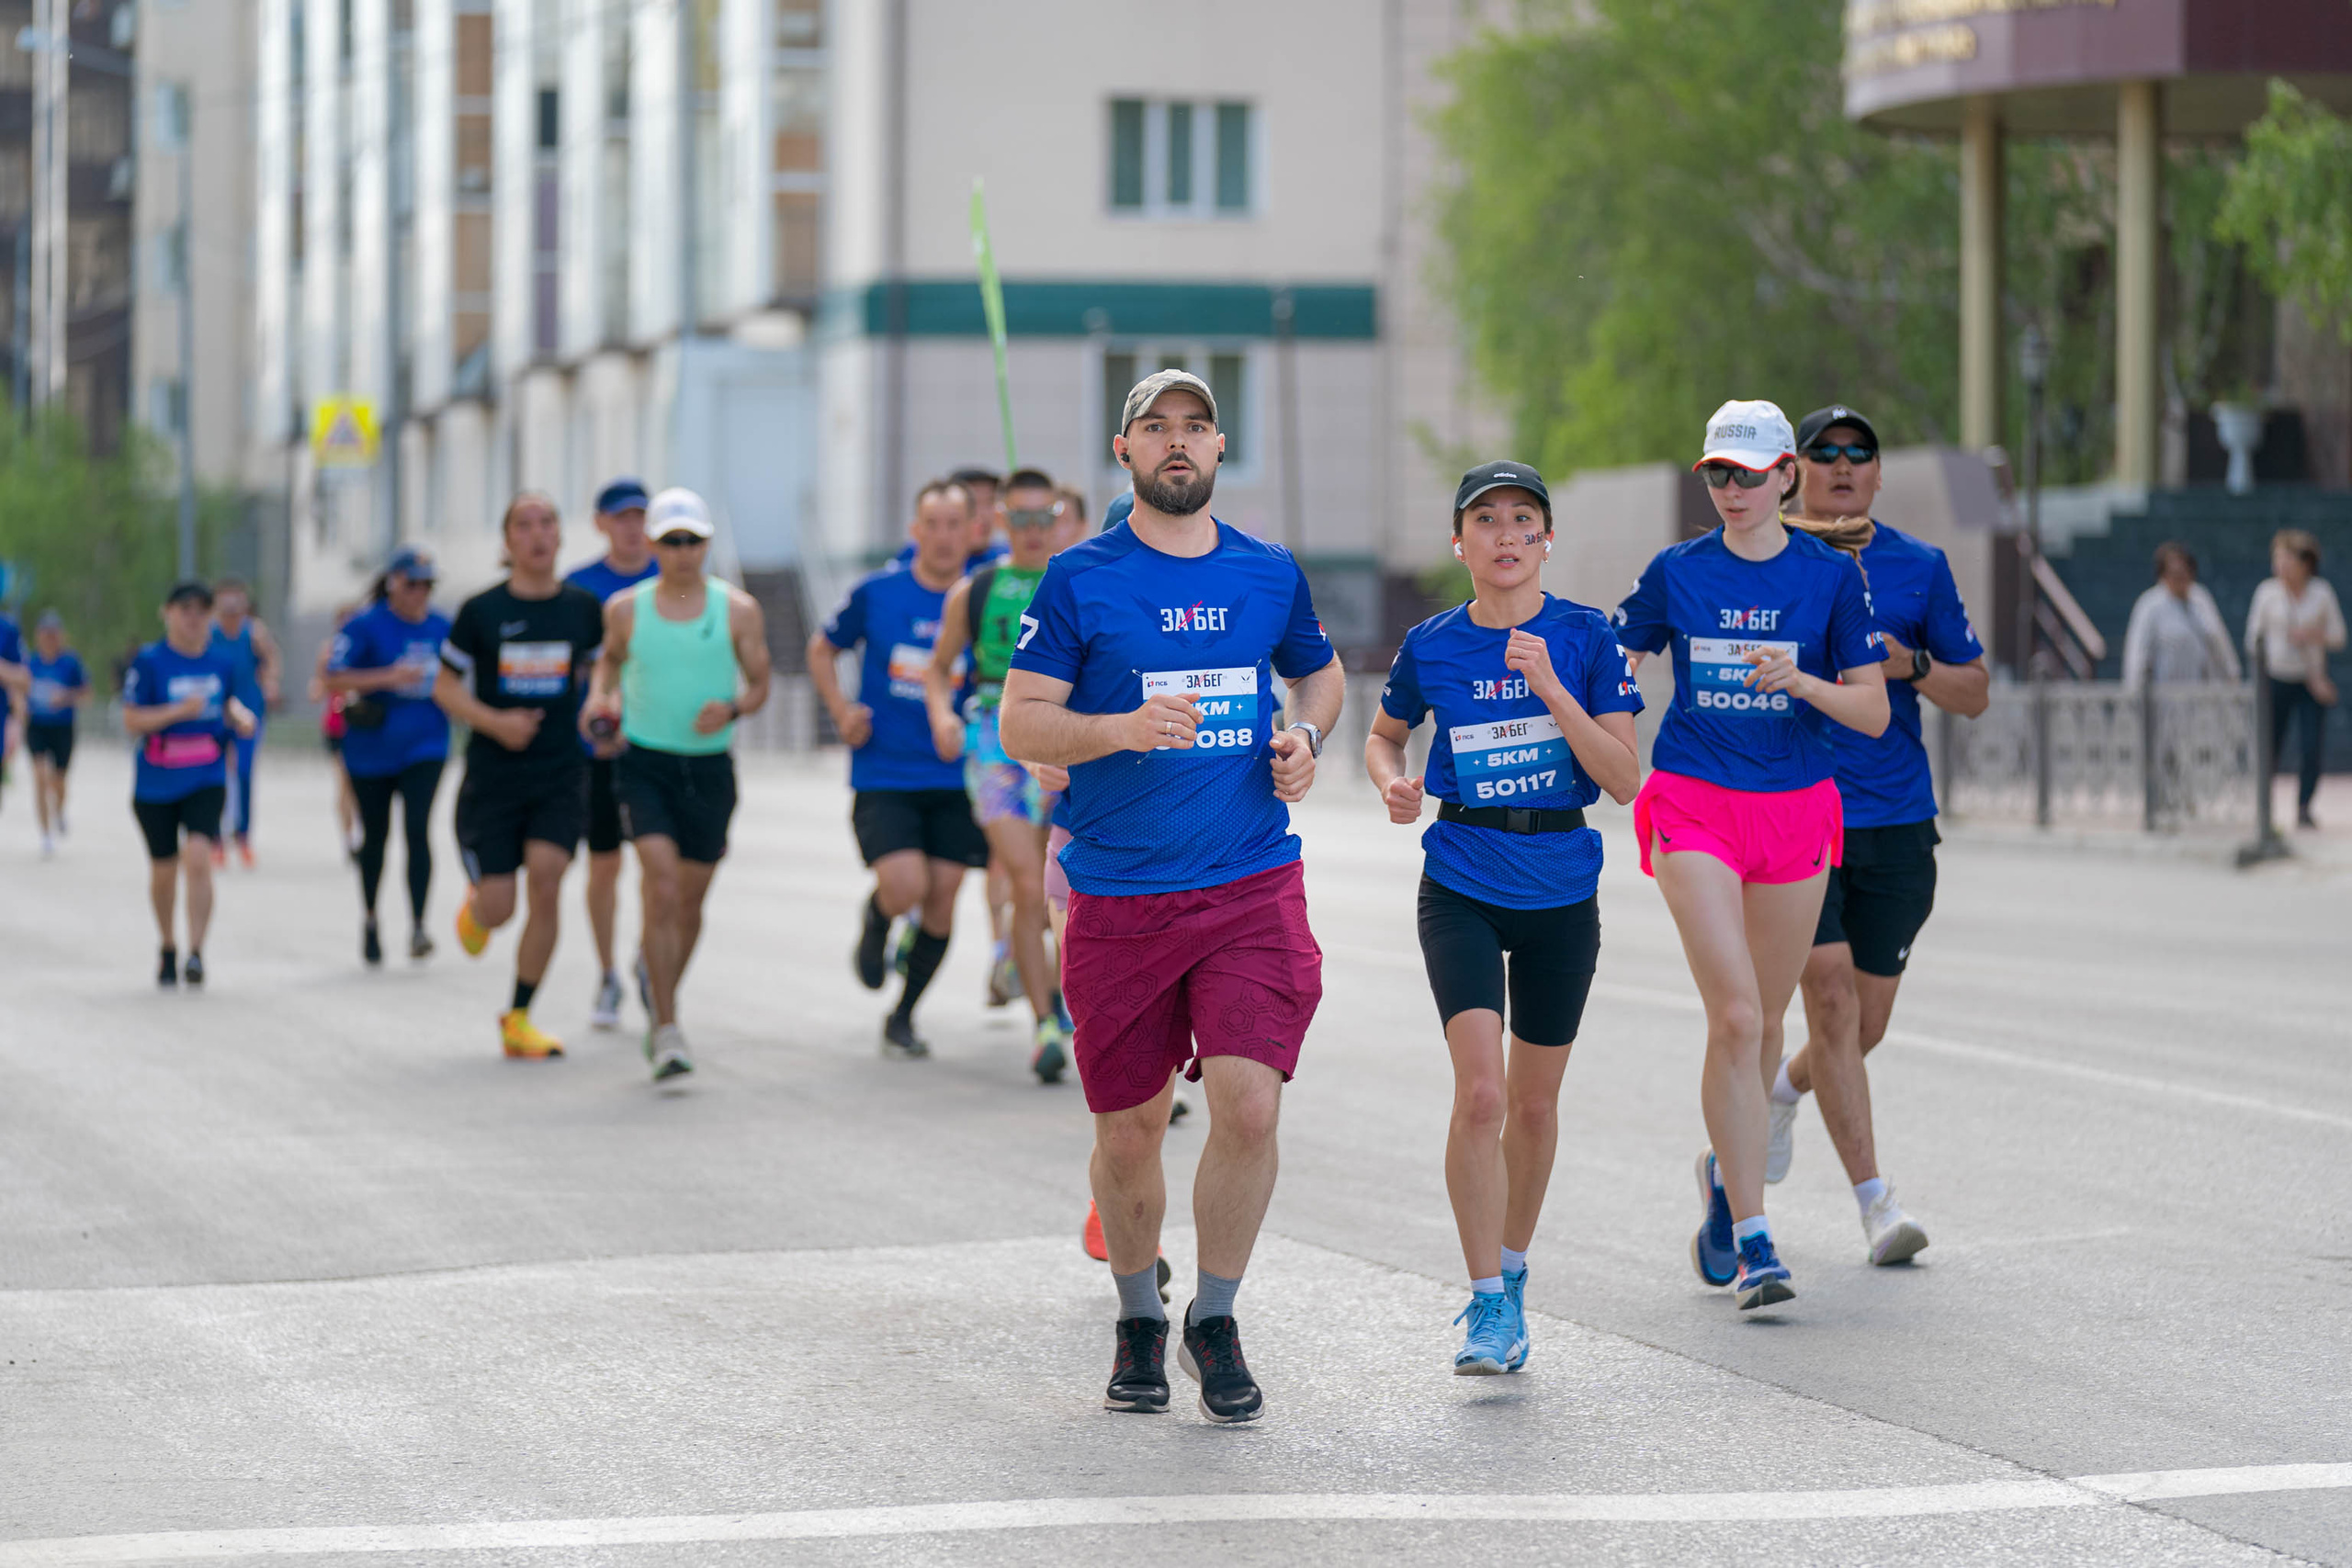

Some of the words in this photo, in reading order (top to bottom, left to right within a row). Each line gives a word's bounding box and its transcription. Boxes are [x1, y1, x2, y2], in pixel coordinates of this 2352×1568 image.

[1714, 424, 1757, 440] RUSSIA
[1697, 691, 1789, 711] 50046
[1476, 770, 1556, 799] 50117
